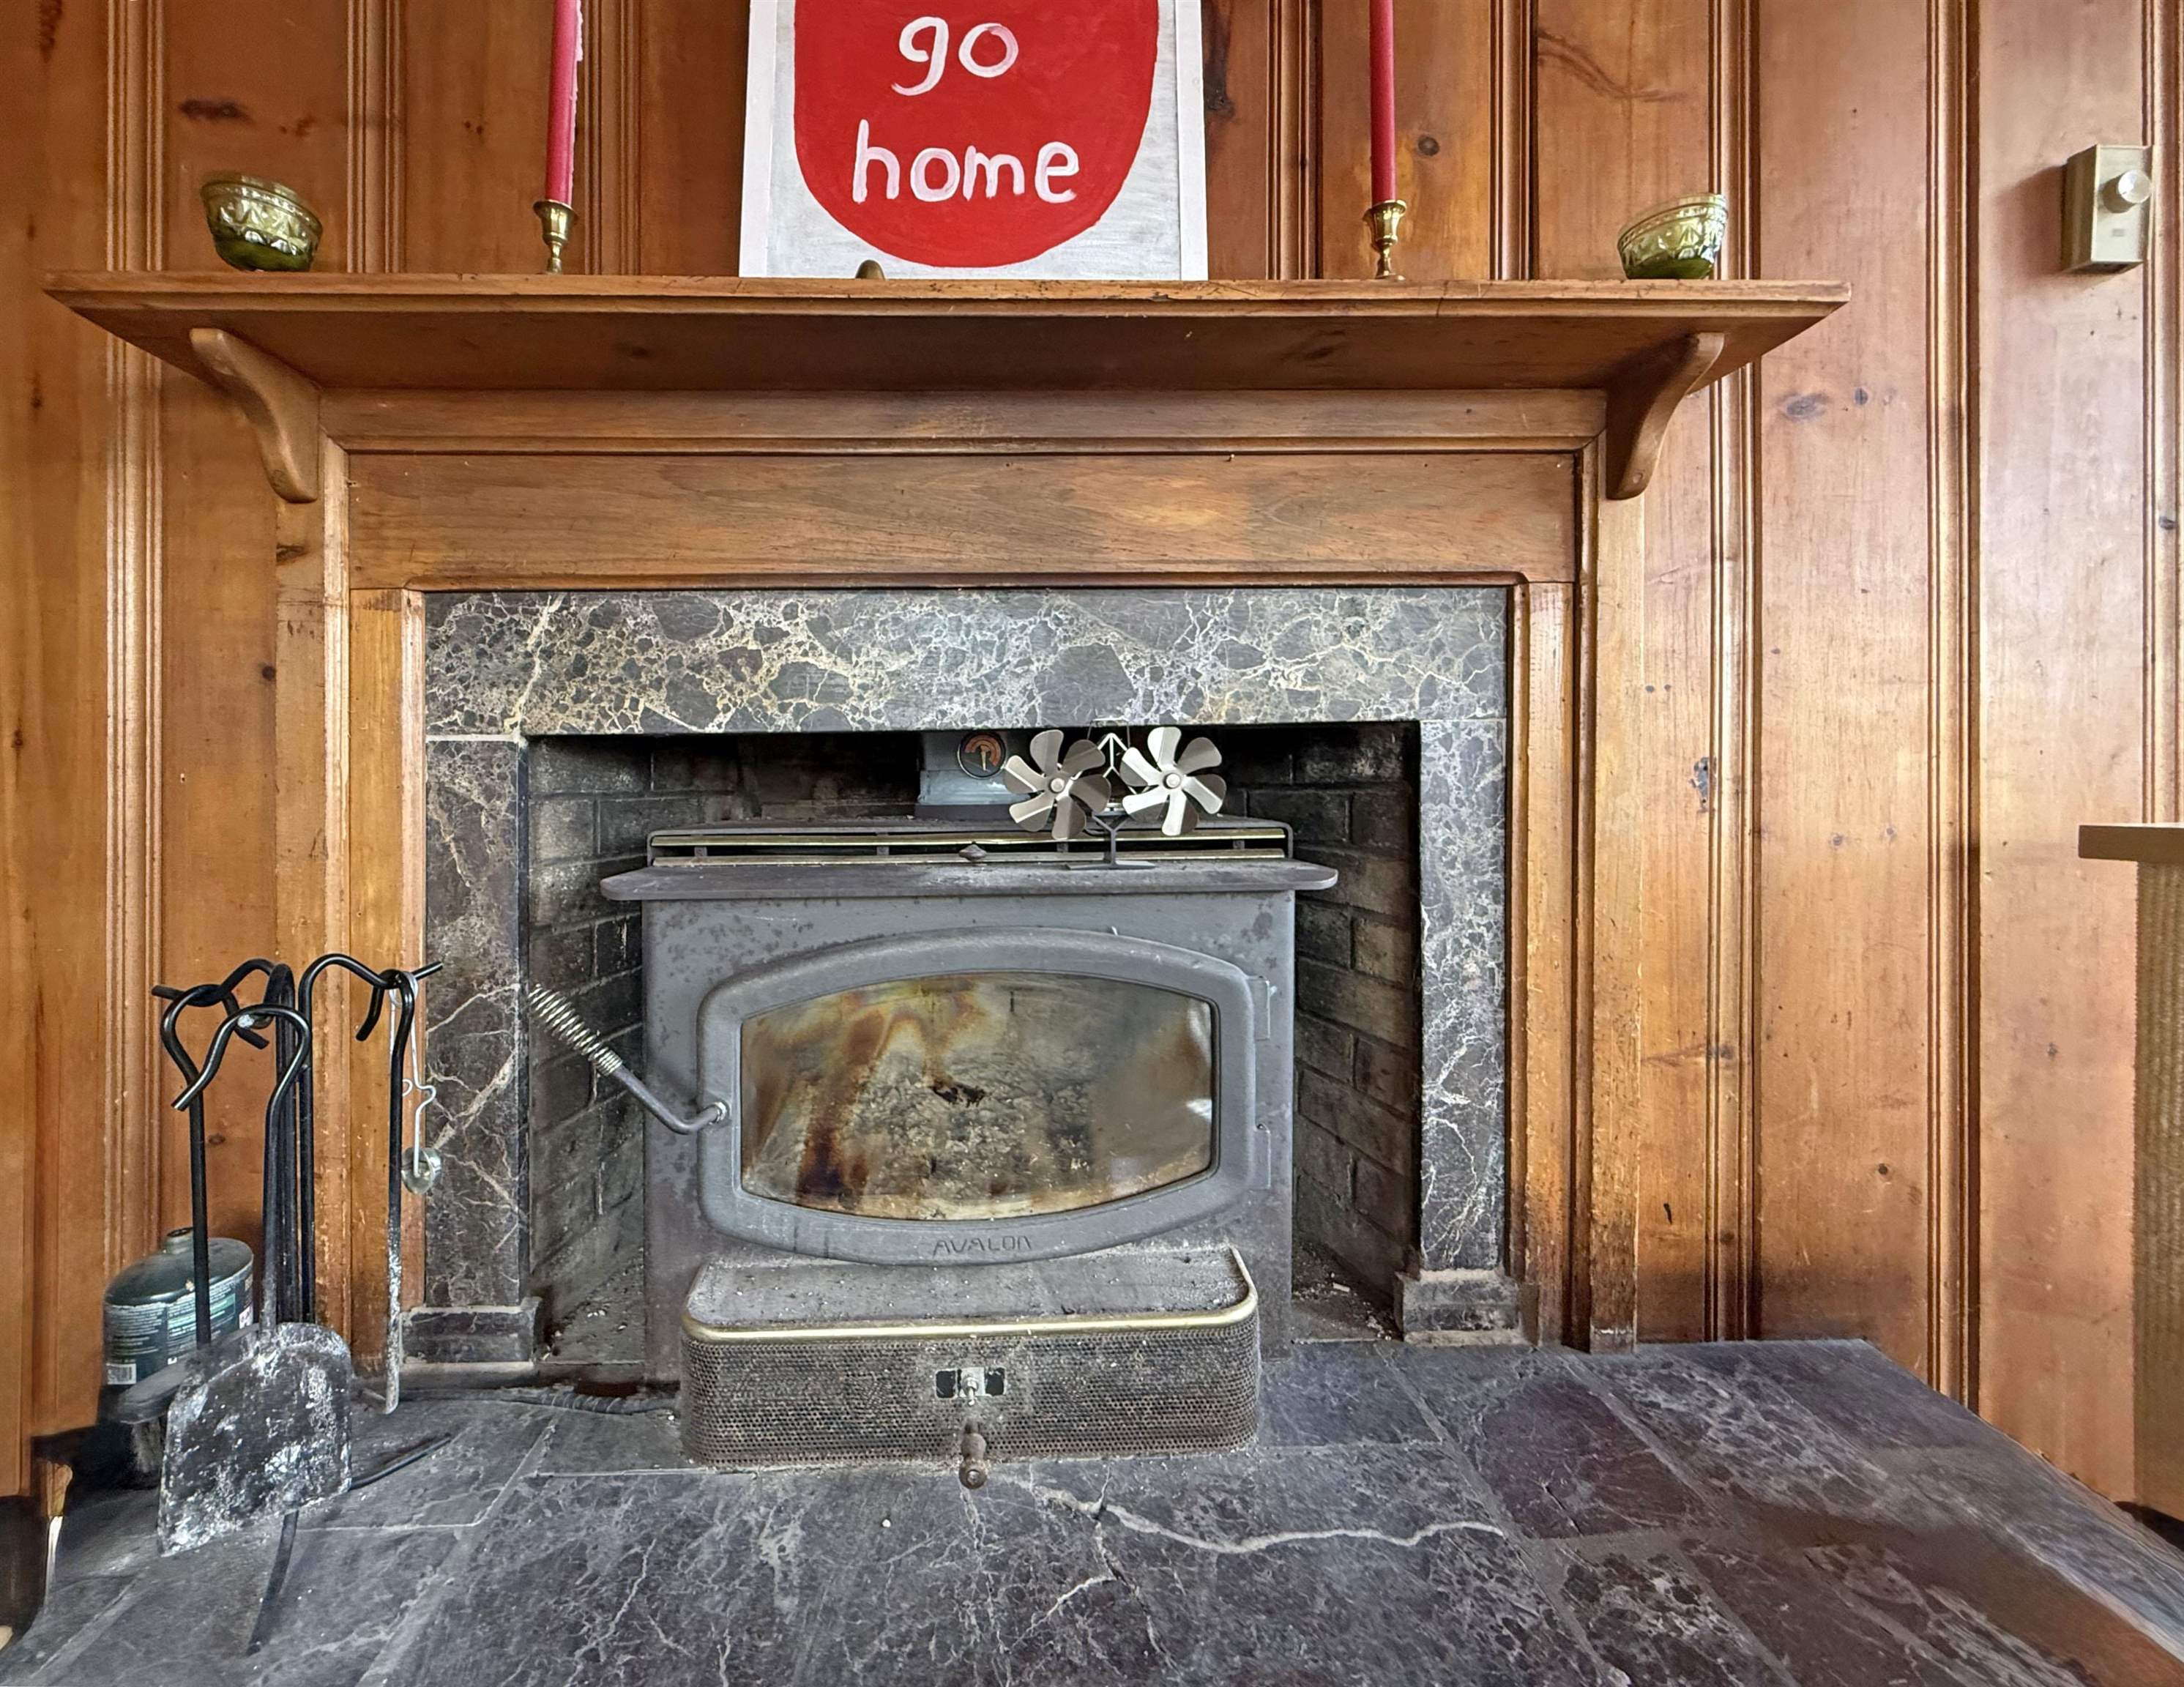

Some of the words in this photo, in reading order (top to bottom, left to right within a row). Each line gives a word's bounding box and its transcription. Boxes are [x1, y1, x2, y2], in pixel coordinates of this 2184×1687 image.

[891, 16, 1019, 96] go
[852, 119, 1079, 204] home
[932, 1235, 1032, 1258] AVALON
